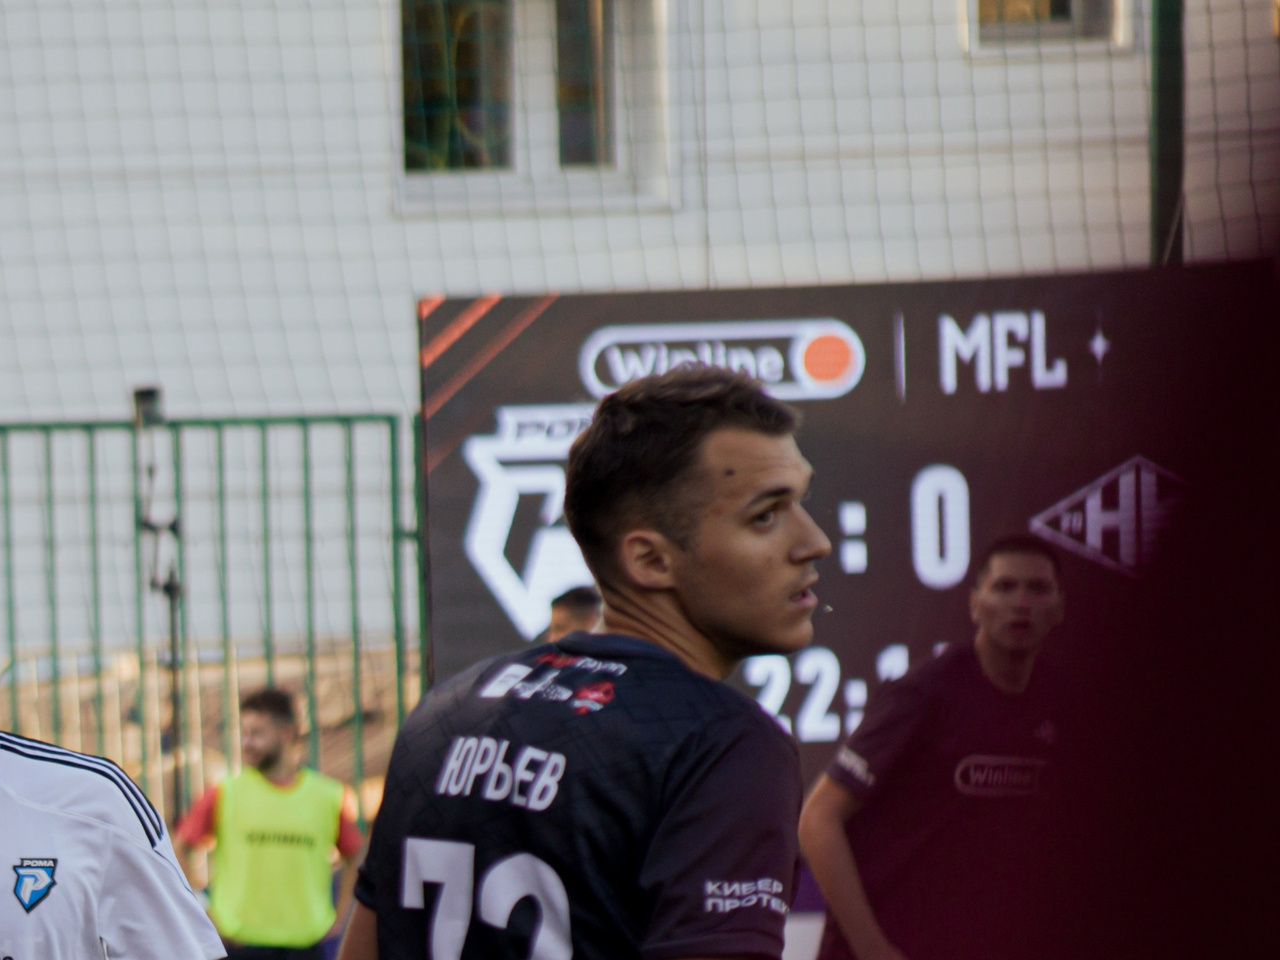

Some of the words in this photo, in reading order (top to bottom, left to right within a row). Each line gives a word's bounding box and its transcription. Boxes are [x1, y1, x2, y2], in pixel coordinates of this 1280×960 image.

[938, 310, 1068, 395] MFL
[910, 463, 970, 590] 0
[437, 736, 567, 812] ЮРЬЕВ
